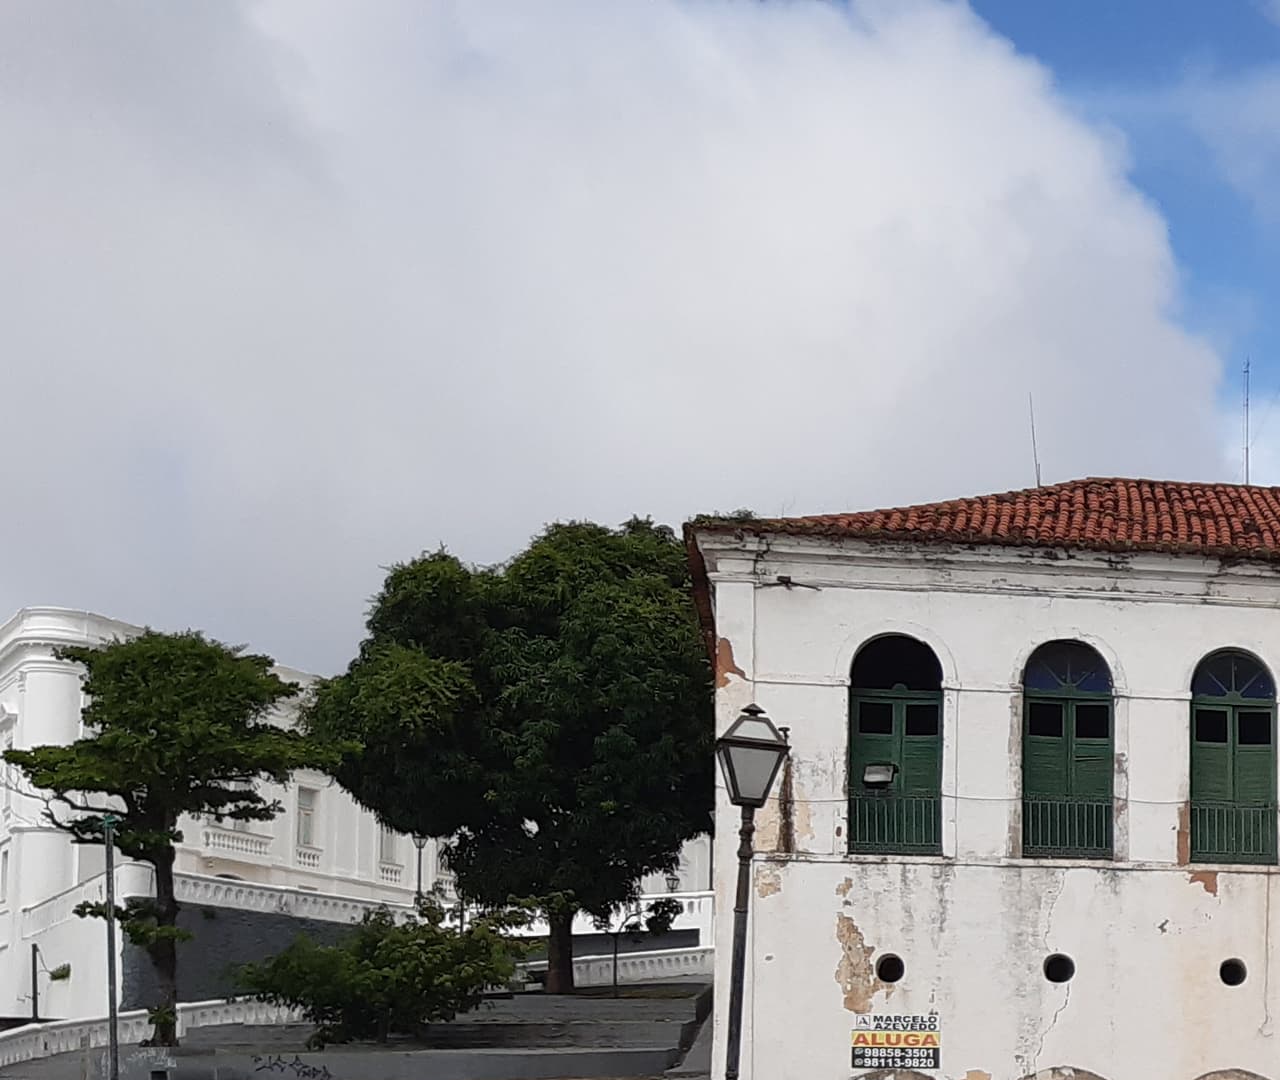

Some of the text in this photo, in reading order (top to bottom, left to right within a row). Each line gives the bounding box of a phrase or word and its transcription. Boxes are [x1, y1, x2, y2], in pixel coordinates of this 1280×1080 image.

[873, 1015, 938, 1023] MARCELO
[874, 1023, 937, 1031] AZEVEDO
[853, 1033, 938, 1046] ALUGA
[864, 1058, 934, 1067] 98113-9820
